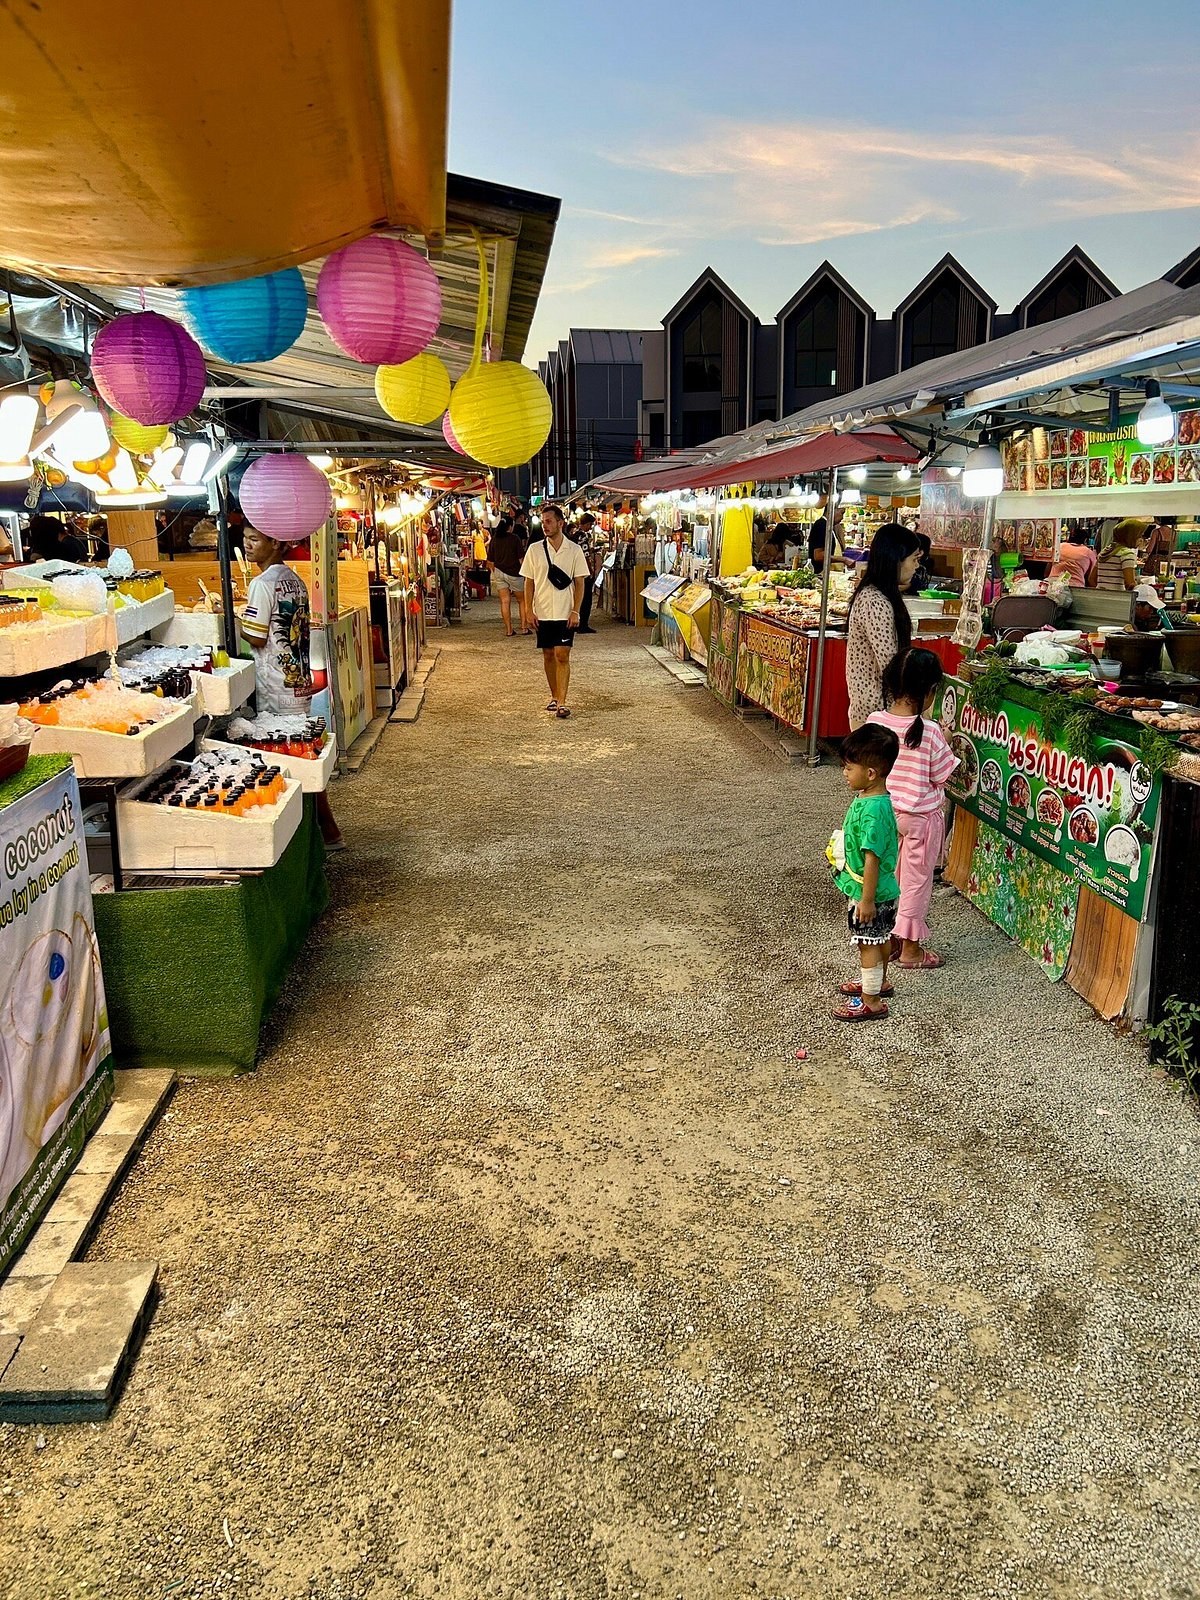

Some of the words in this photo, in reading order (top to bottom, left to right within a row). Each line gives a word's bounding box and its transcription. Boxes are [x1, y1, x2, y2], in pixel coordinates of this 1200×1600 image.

[1008, 734, 1115, 806] นรกแตก!
[5, 793, 75, 878] coconut
[12, 886, 27, 916] loy
[28, 876, 39, 904] in
[40, 872, 47, 894] a
[1100, 885, 1127, 907] Landmark
[0, 1240, 9, 1257] by
[9, 1211, 30, 1247] people
[27, 1193, 42, 1214] with
[38, 1174, 52, 1195] food
[50, 1145, 73, 1180] allergies.
